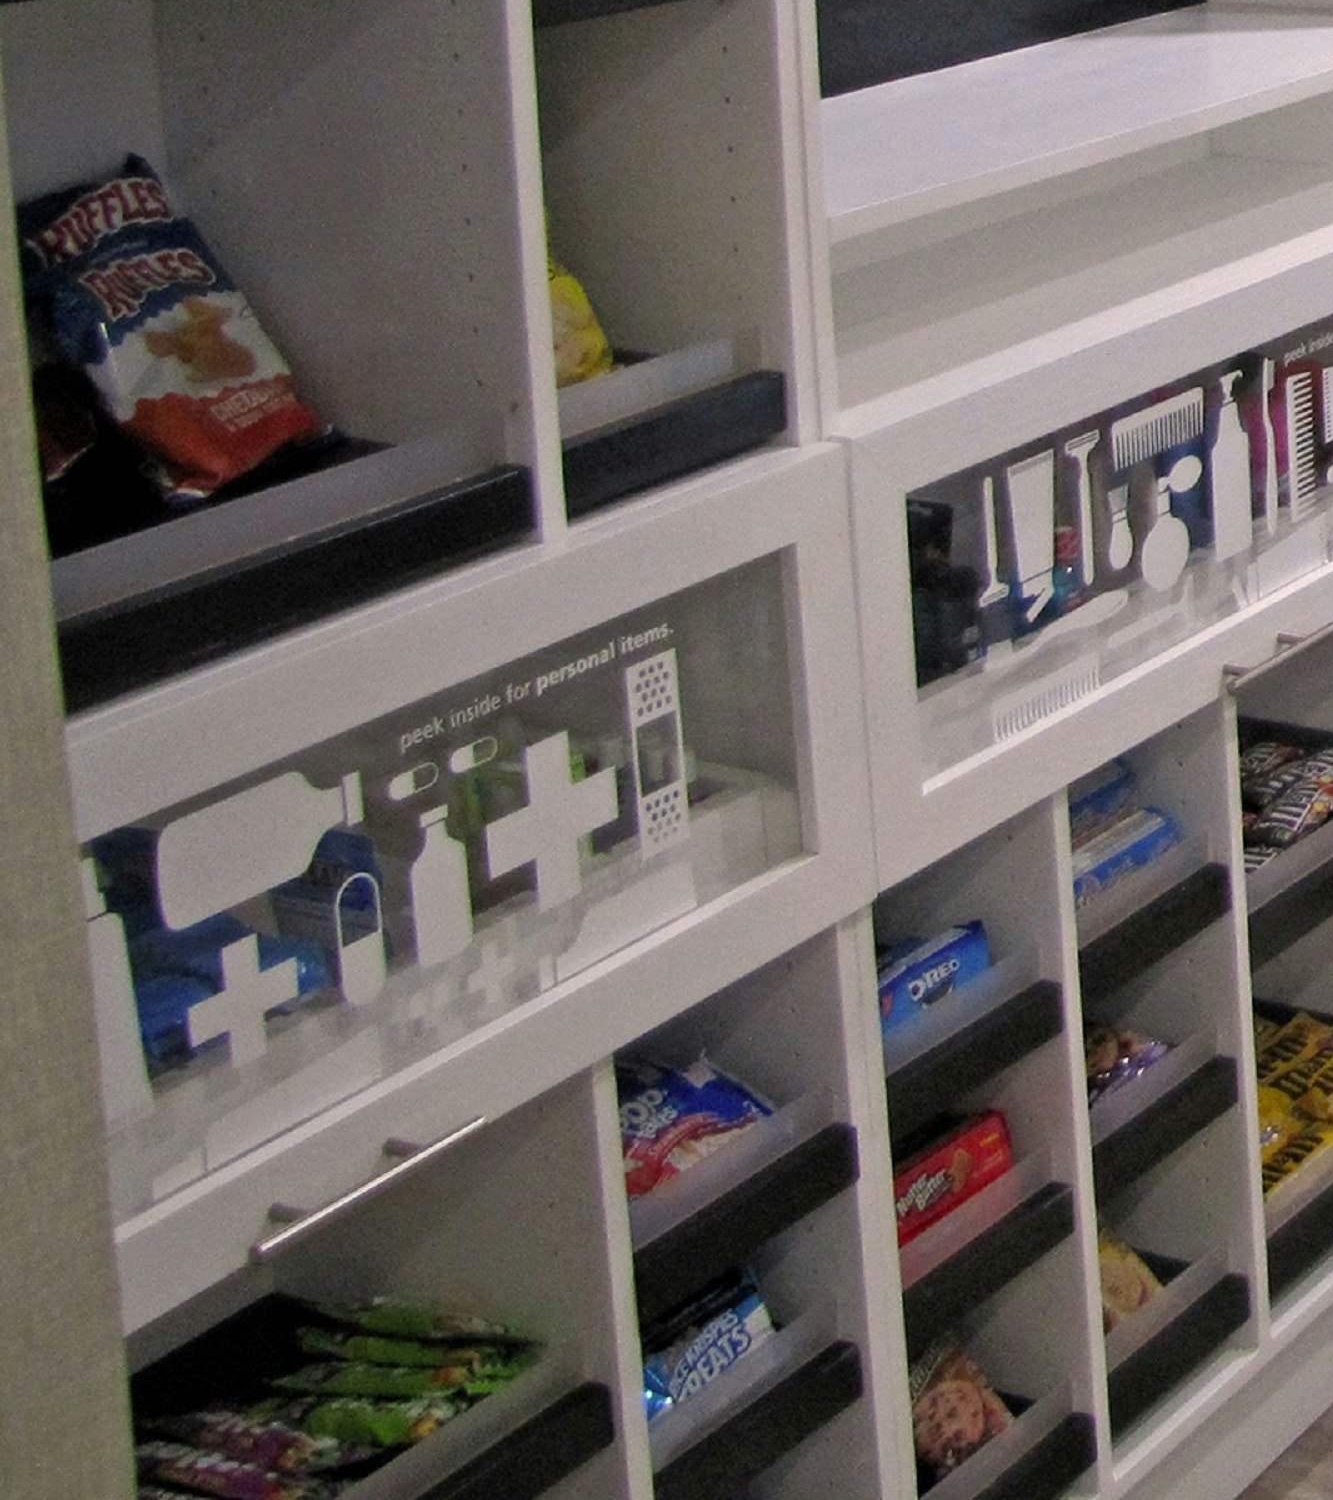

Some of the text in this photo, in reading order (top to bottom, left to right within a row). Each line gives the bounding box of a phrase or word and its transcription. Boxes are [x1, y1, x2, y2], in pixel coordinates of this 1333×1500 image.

[28, 177, 173, 264] RUFFLES
[400, 621, 675, 753] peek inside for personal items.
[908, 959, 960, 1001] OREO
